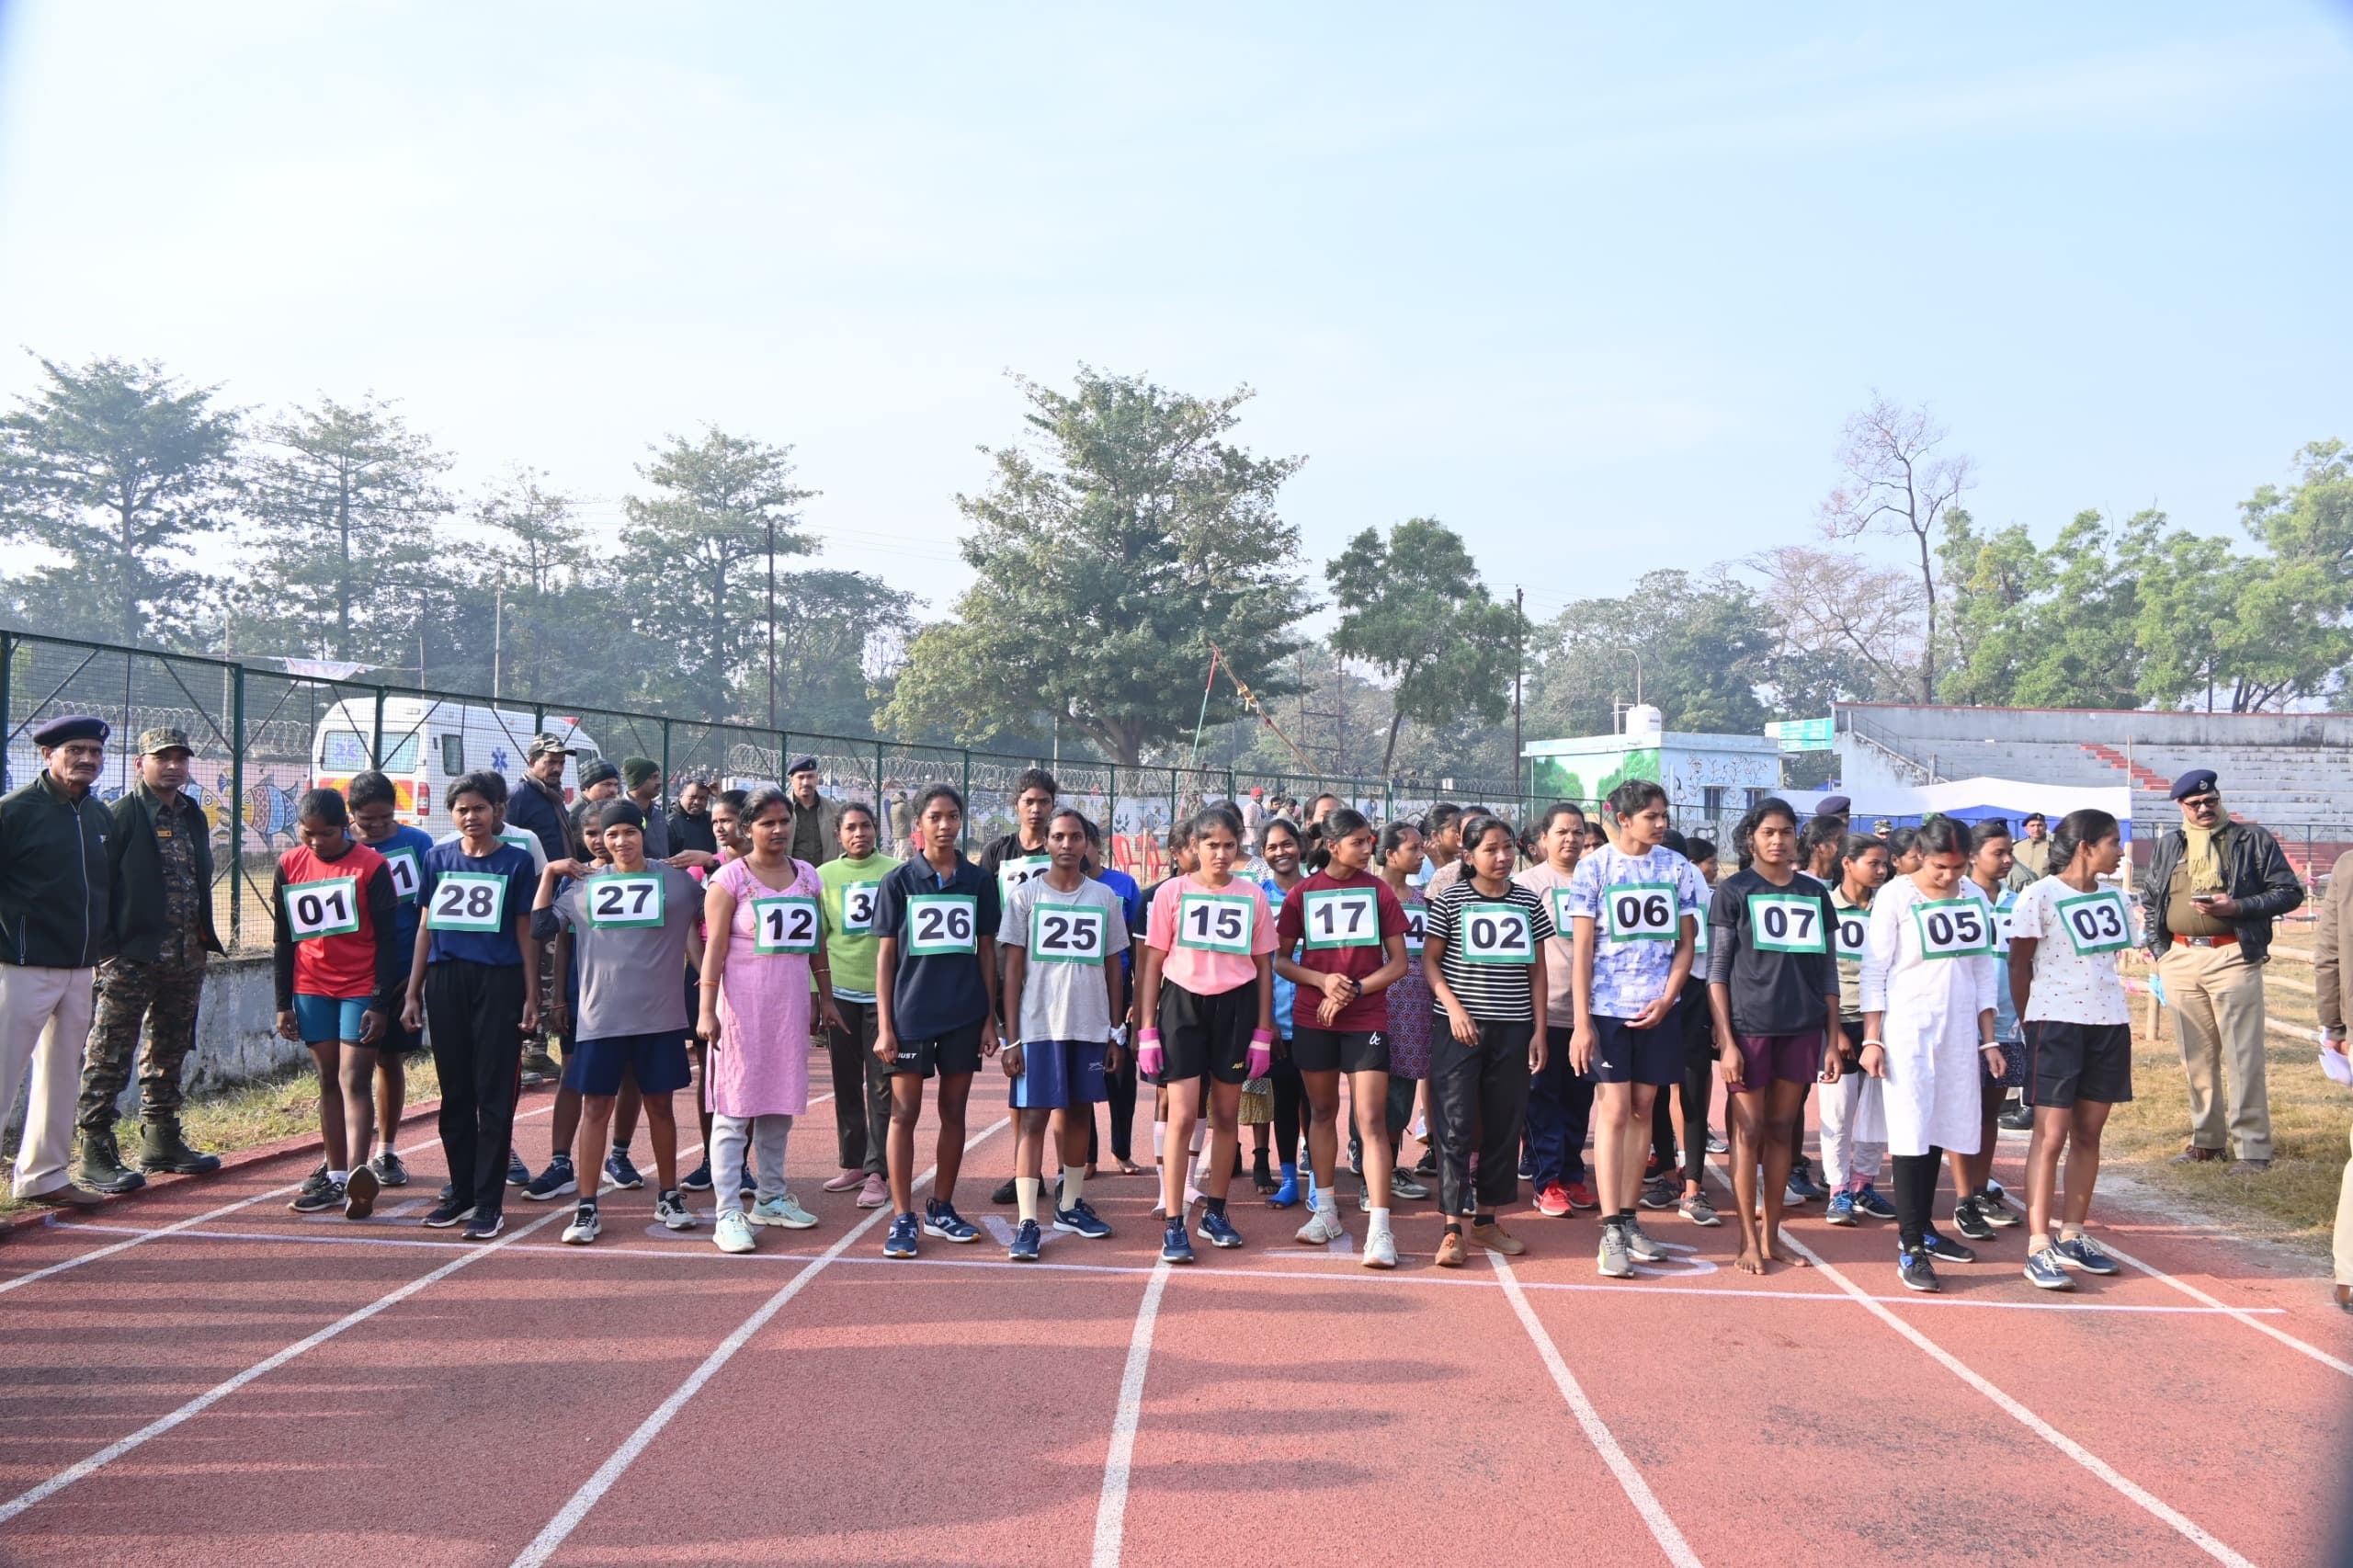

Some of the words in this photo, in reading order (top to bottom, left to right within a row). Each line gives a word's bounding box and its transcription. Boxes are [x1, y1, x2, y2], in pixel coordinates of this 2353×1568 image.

[392, 860, 413, 889] 1
[297, 890, 347, 926] 01
[437, 884, 494, 918] 28
[597, 884, 654, 915] 27
[850, 893, 872, 922] 3
[1616, 894, 1670, 928] 06
[766, 908, 813, 940] 12
[917, 907, 971, 940] 26
[1042, 916, 1097, 950] 25
[1190, 904, 1242, 939] 15
[1314, 901, 1367, 935] 17
[1405, 915, 1426, 943] 4
[1471, 917, 1526, 949] 02
[1764, 906, 1815, 938] 07
[1841, 920, 1865, 949] 0
[1927, 911, 1983, 946] 05
[2072, 904, 2122, 940] 03
